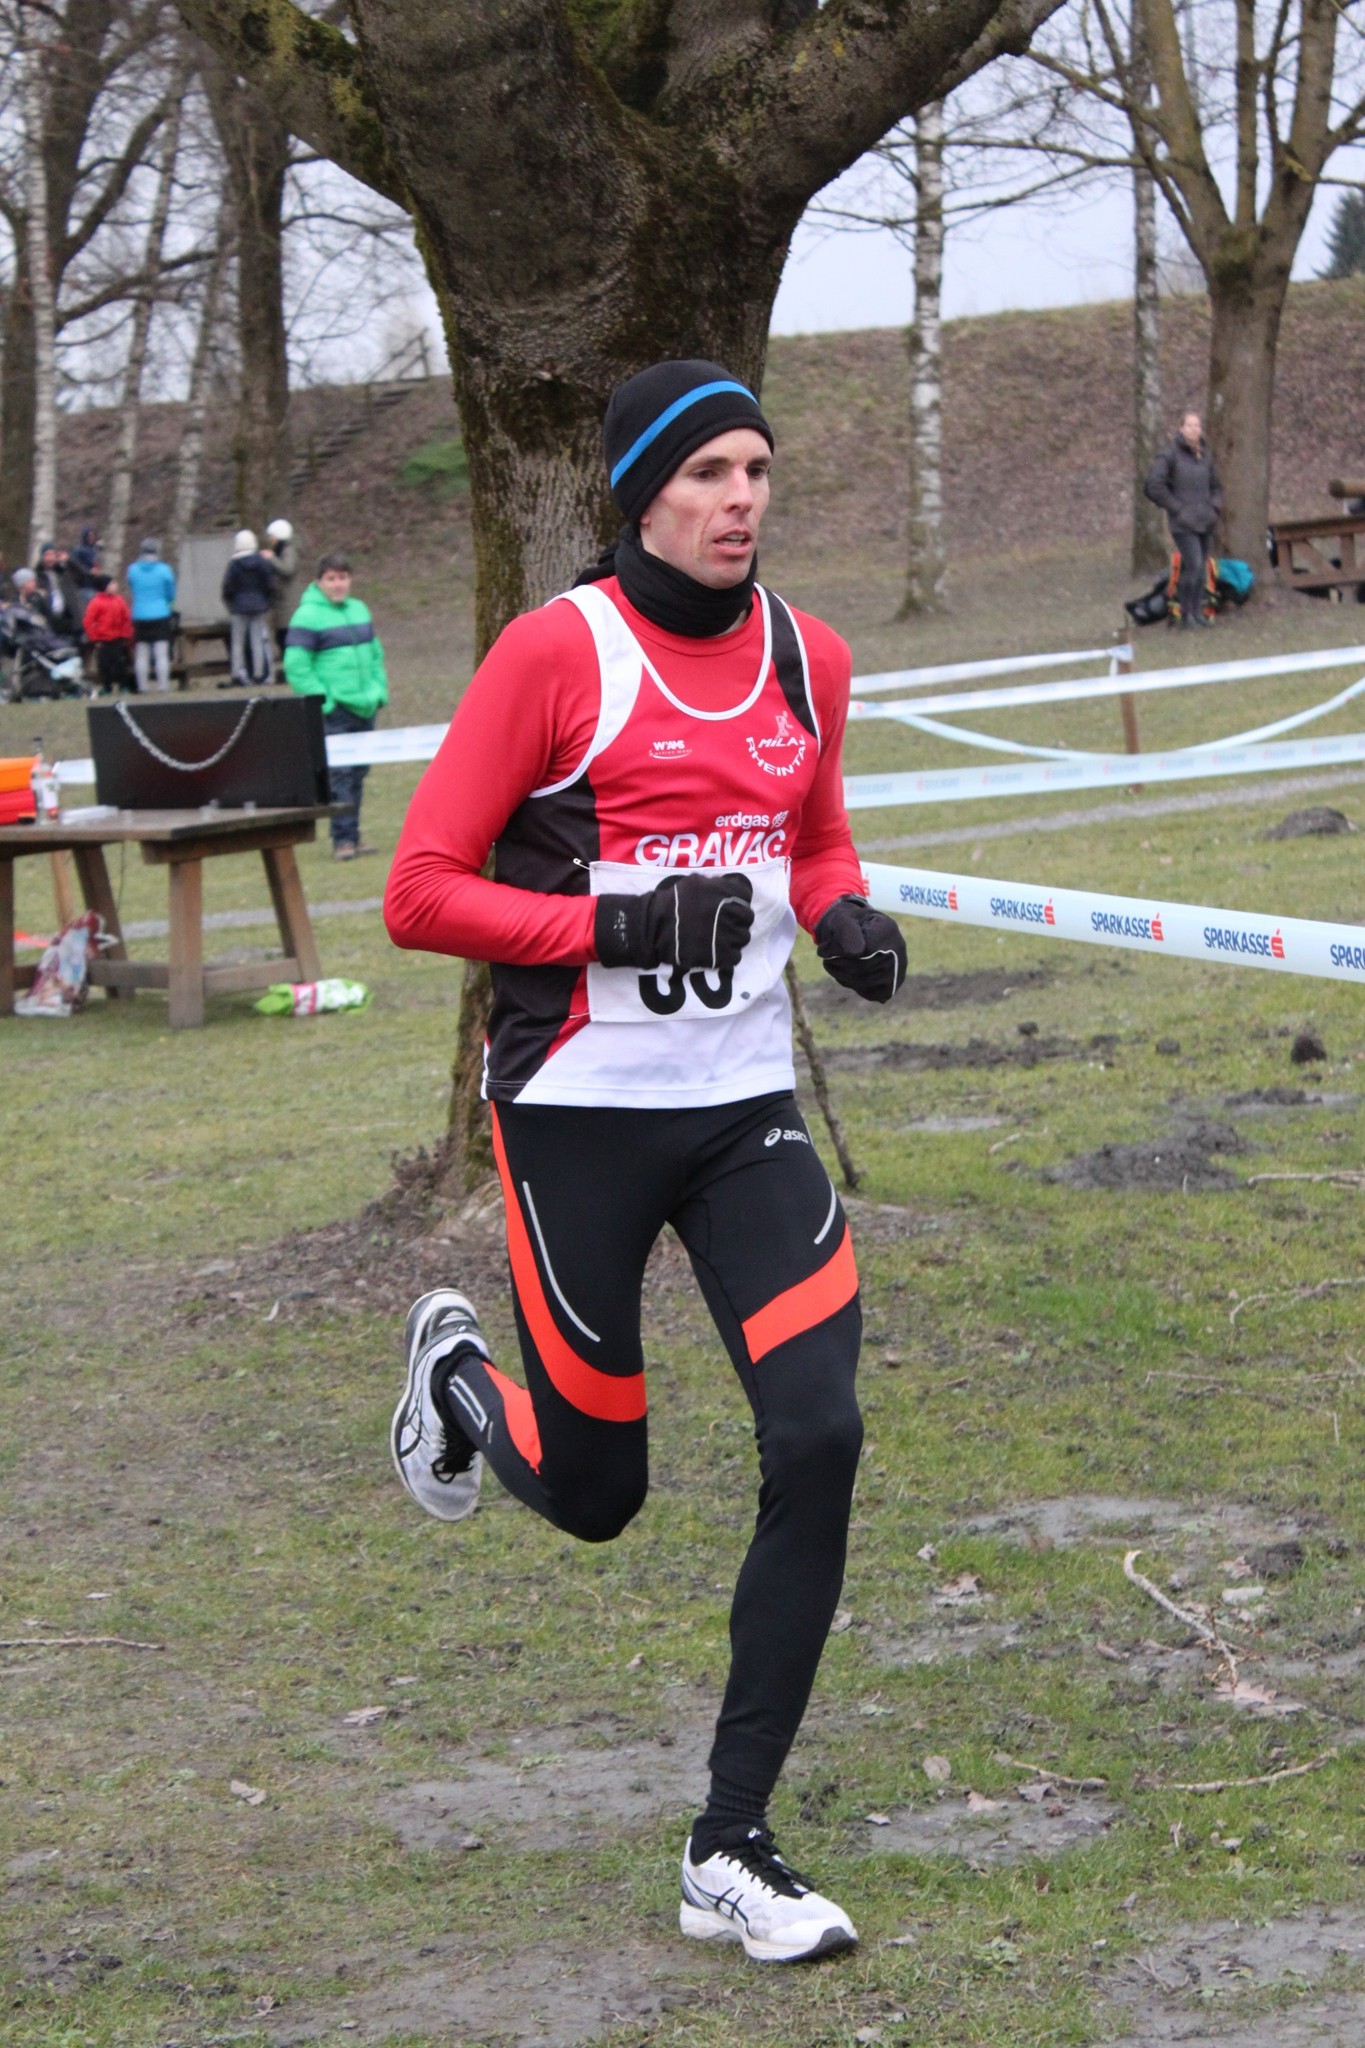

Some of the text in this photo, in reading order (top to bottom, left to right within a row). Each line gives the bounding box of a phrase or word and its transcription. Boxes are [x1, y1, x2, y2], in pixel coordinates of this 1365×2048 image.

[715, 811, 770, 829] erdgas
[634, 829, 786, 867] GRAVAG
[899, 883, 949, 910] SPARKASSE
[990, 897, 1045, 924] SPARKASSE
[1091, 911, 1152, 940] SPARKASSE
[1203, 926, 1272, 957] SPARKASSE
